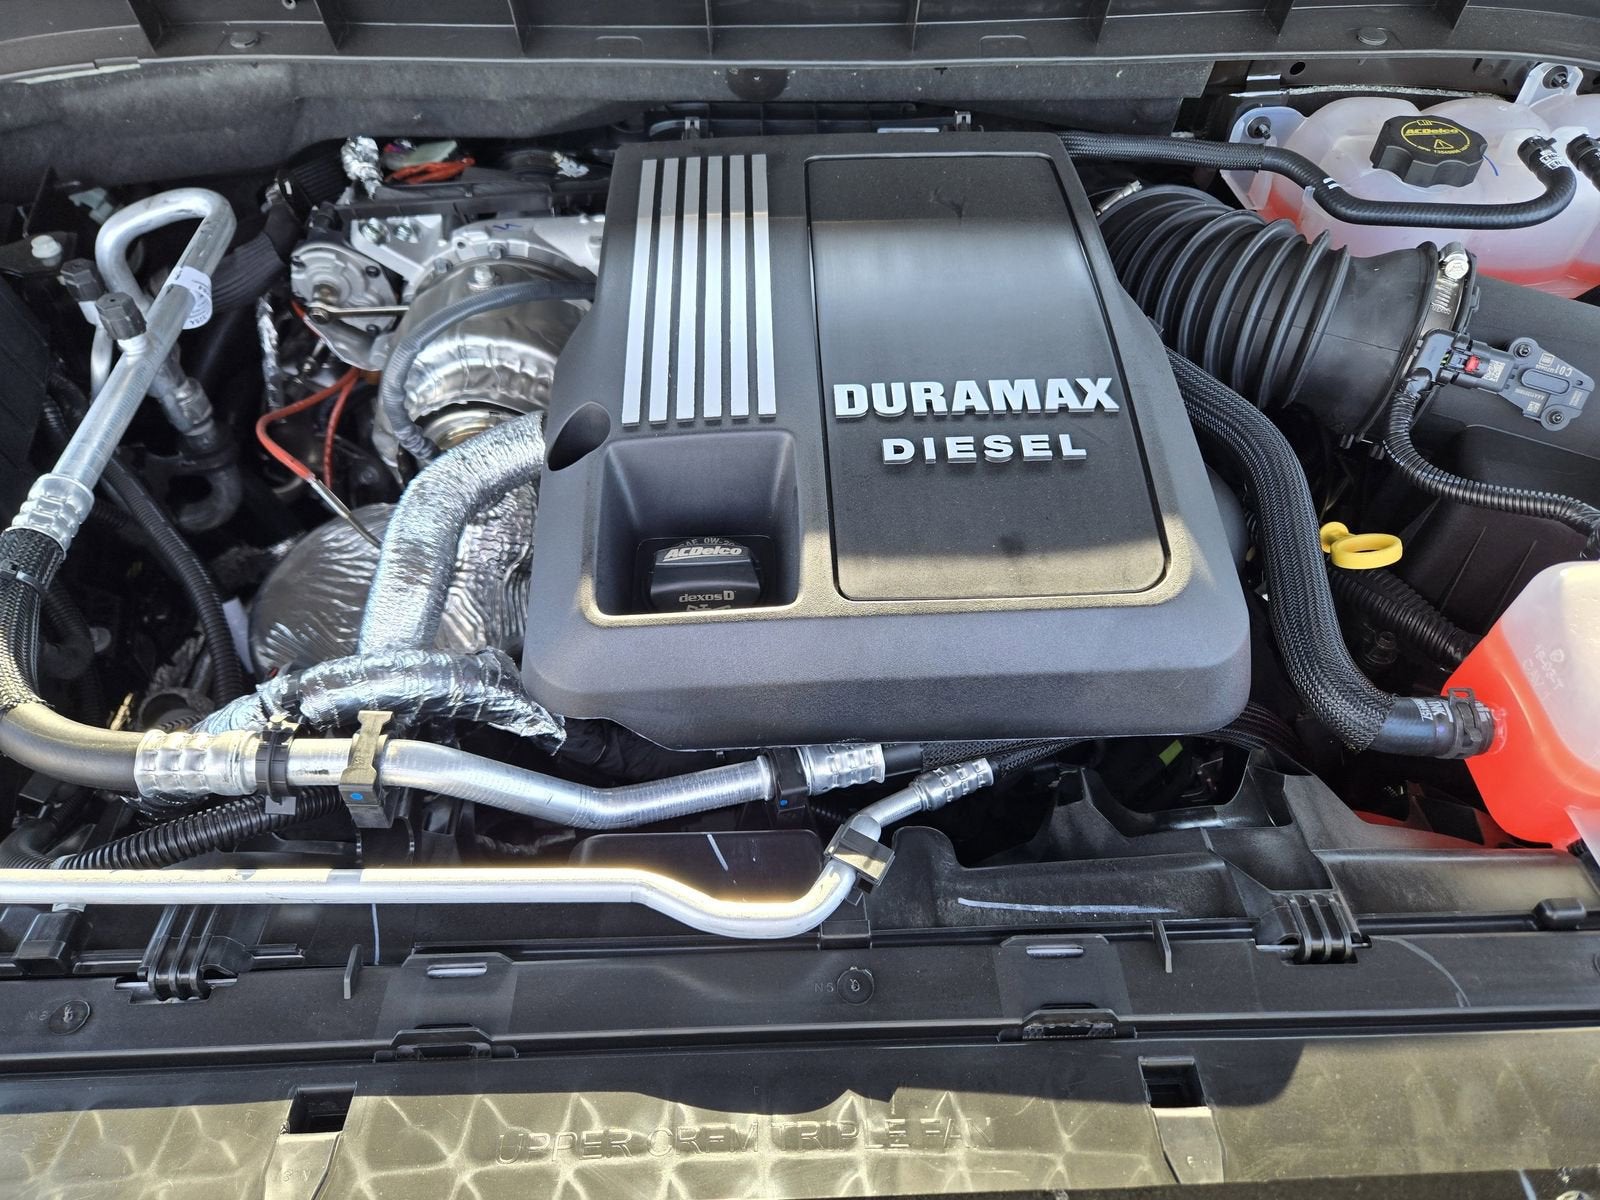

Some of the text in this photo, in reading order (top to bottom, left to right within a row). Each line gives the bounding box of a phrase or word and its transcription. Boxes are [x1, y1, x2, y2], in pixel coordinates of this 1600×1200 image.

[833, 378, 1120, 418] DURAMAX
[882, 434, 1087, 465] DIESEL
[663, 546, 743, 561] ACDelco
[496, 1130, 633, 1164] UPPER
[771, 1118, 910, 1151] TRIPLE
[919, 1117, 996, 1149] FAN
